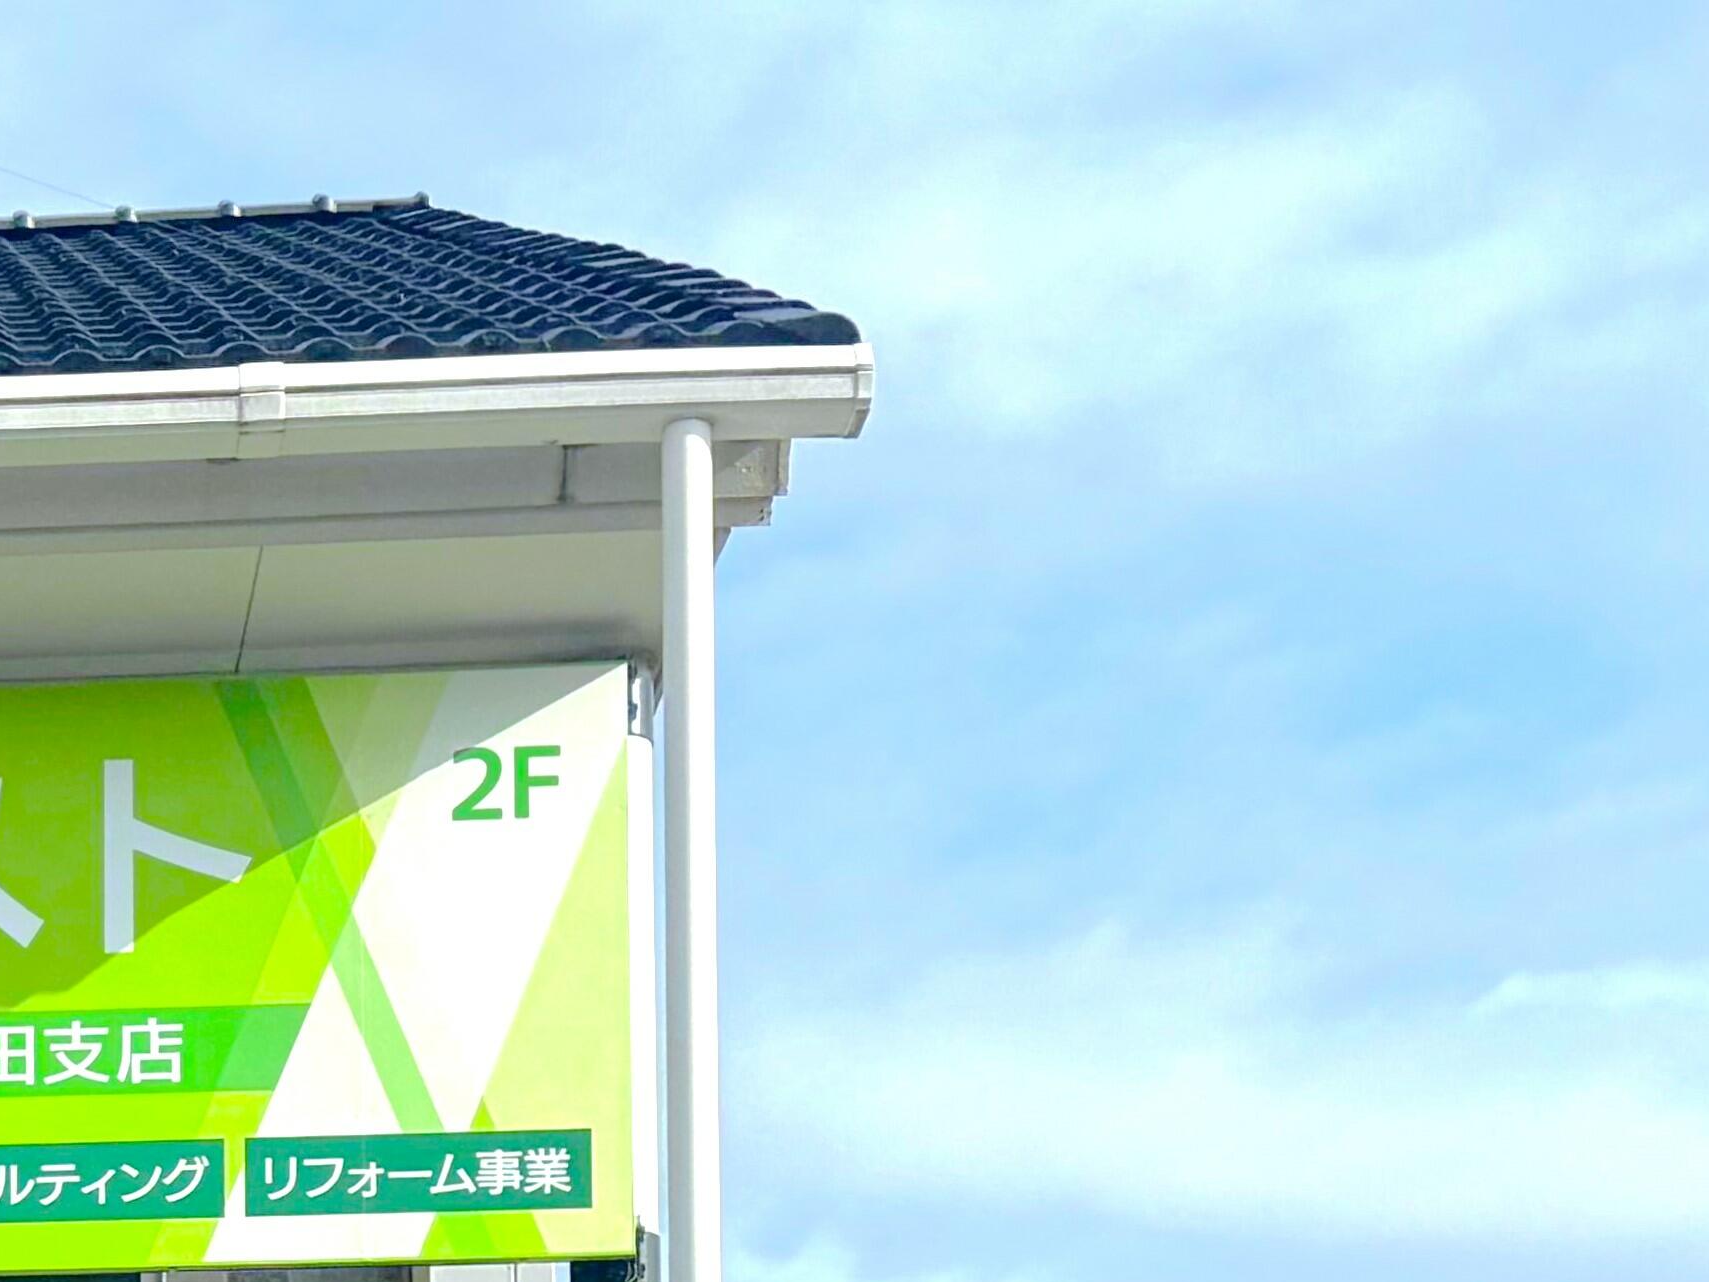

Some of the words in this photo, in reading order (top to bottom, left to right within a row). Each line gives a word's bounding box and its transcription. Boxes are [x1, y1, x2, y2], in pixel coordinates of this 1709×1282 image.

[449, 744, 562, 822] 2F
[260, 1145, 574, 1201] リフォーム事業
